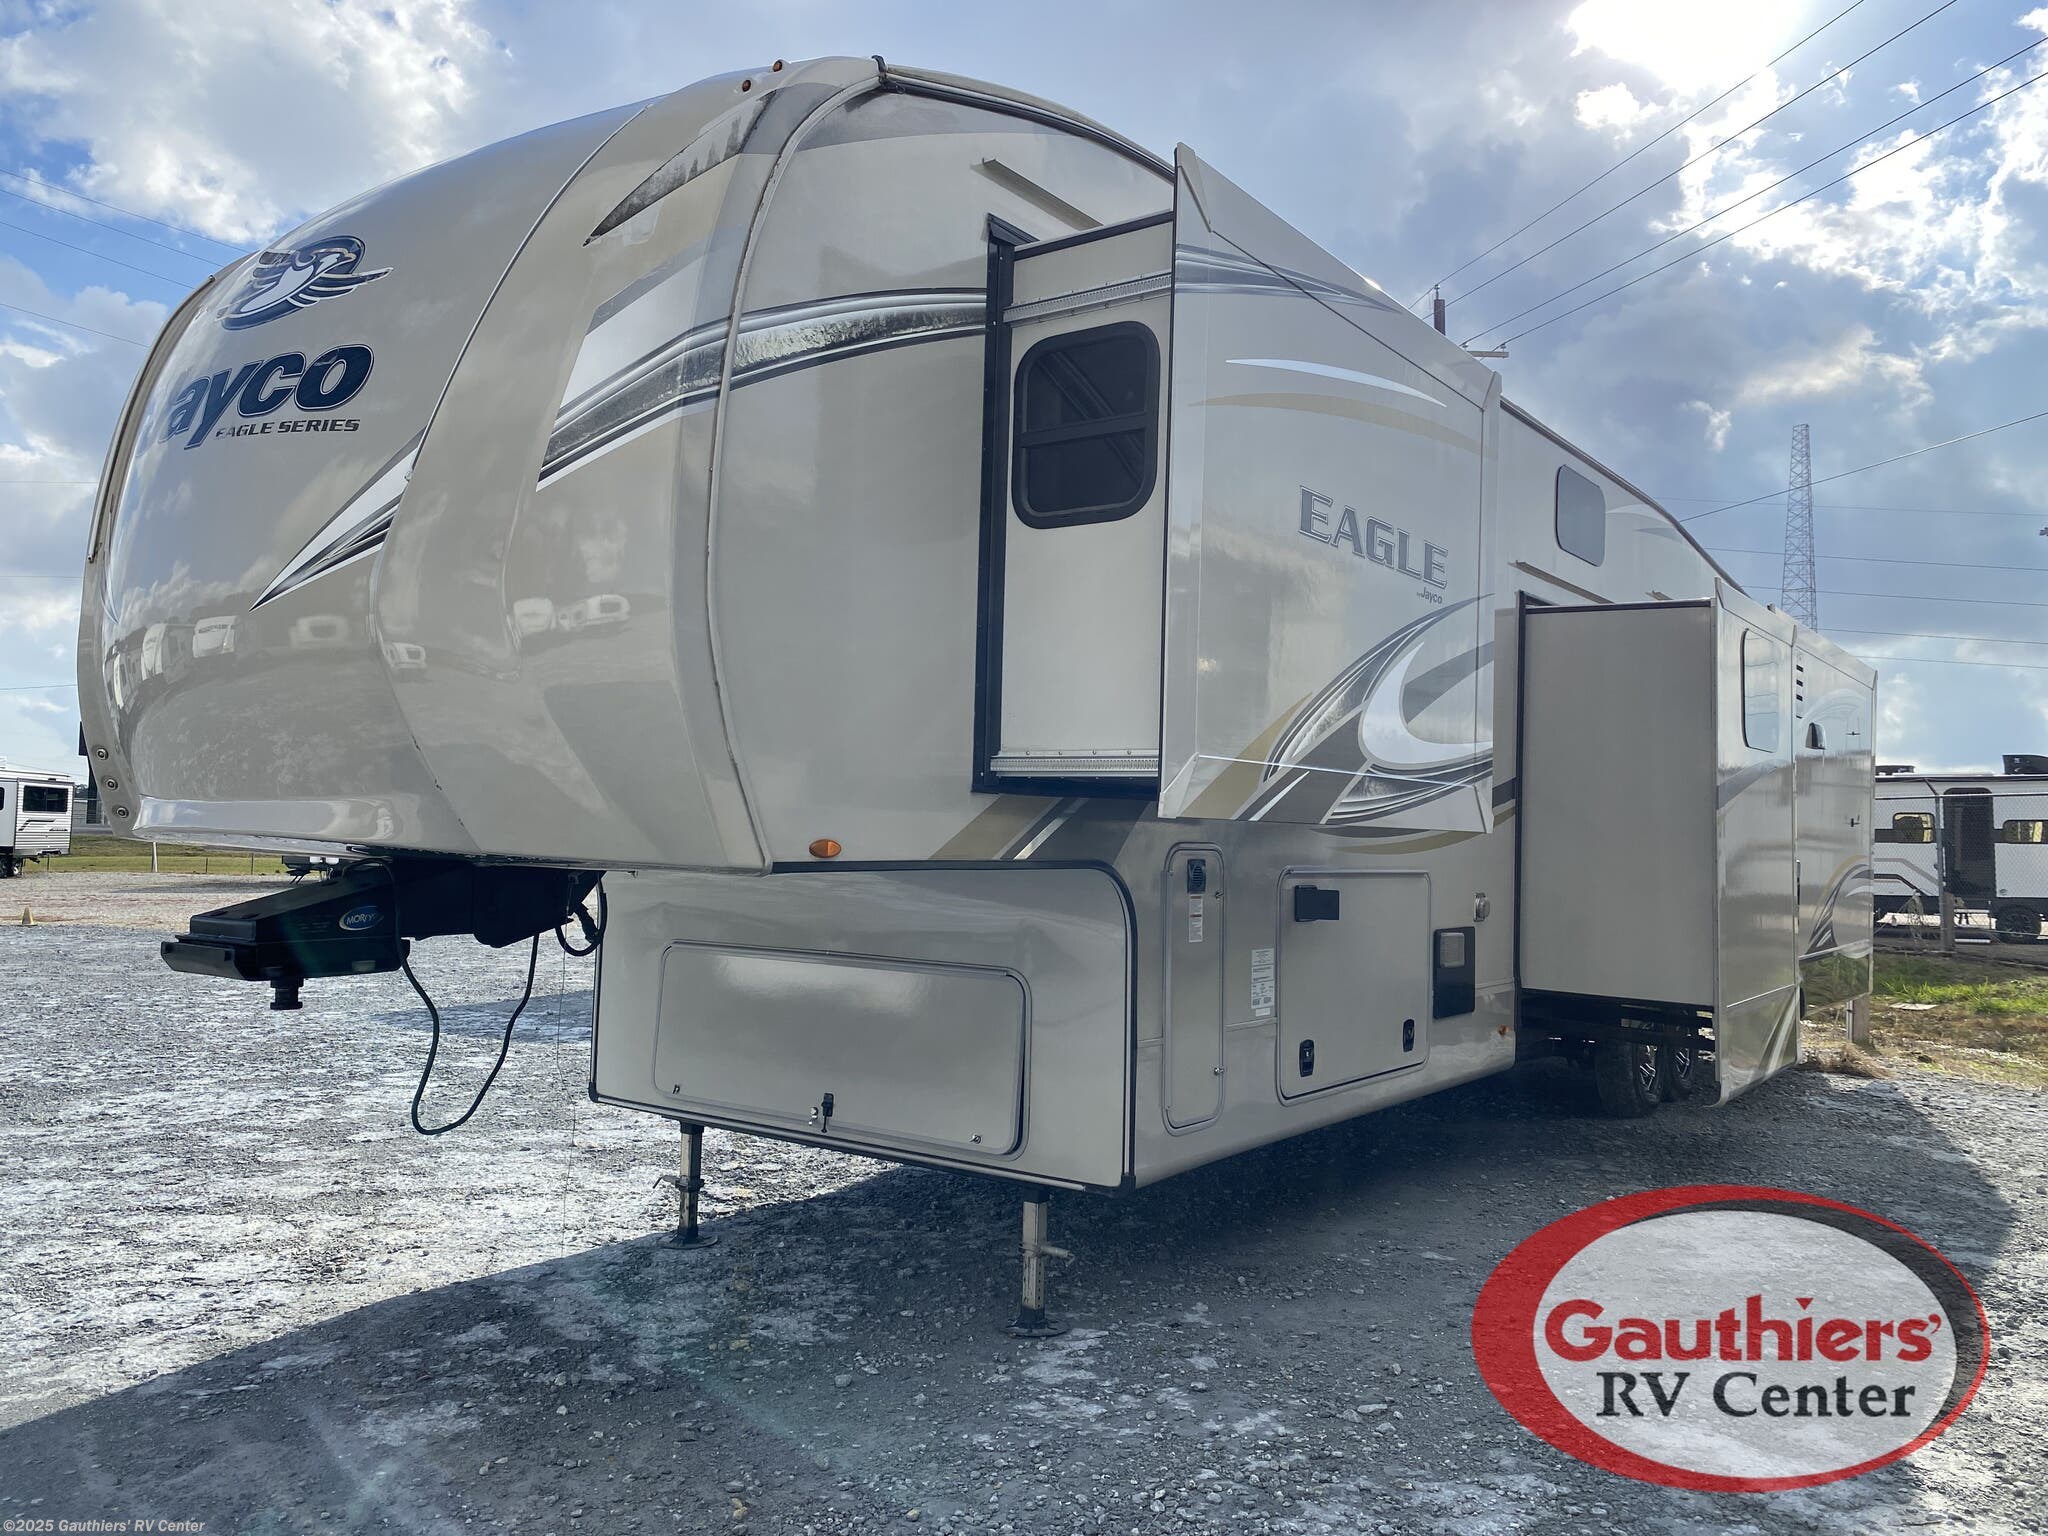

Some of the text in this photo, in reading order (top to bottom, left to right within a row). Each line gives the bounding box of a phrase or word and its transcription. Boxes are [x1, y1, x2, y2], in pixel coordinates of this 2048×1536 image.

[215, 418, 361, 440] EAGLE SERIES
[1299, 484, 1449, 590] EAGLE
[1422, 586, 1443, 604] Jayco
